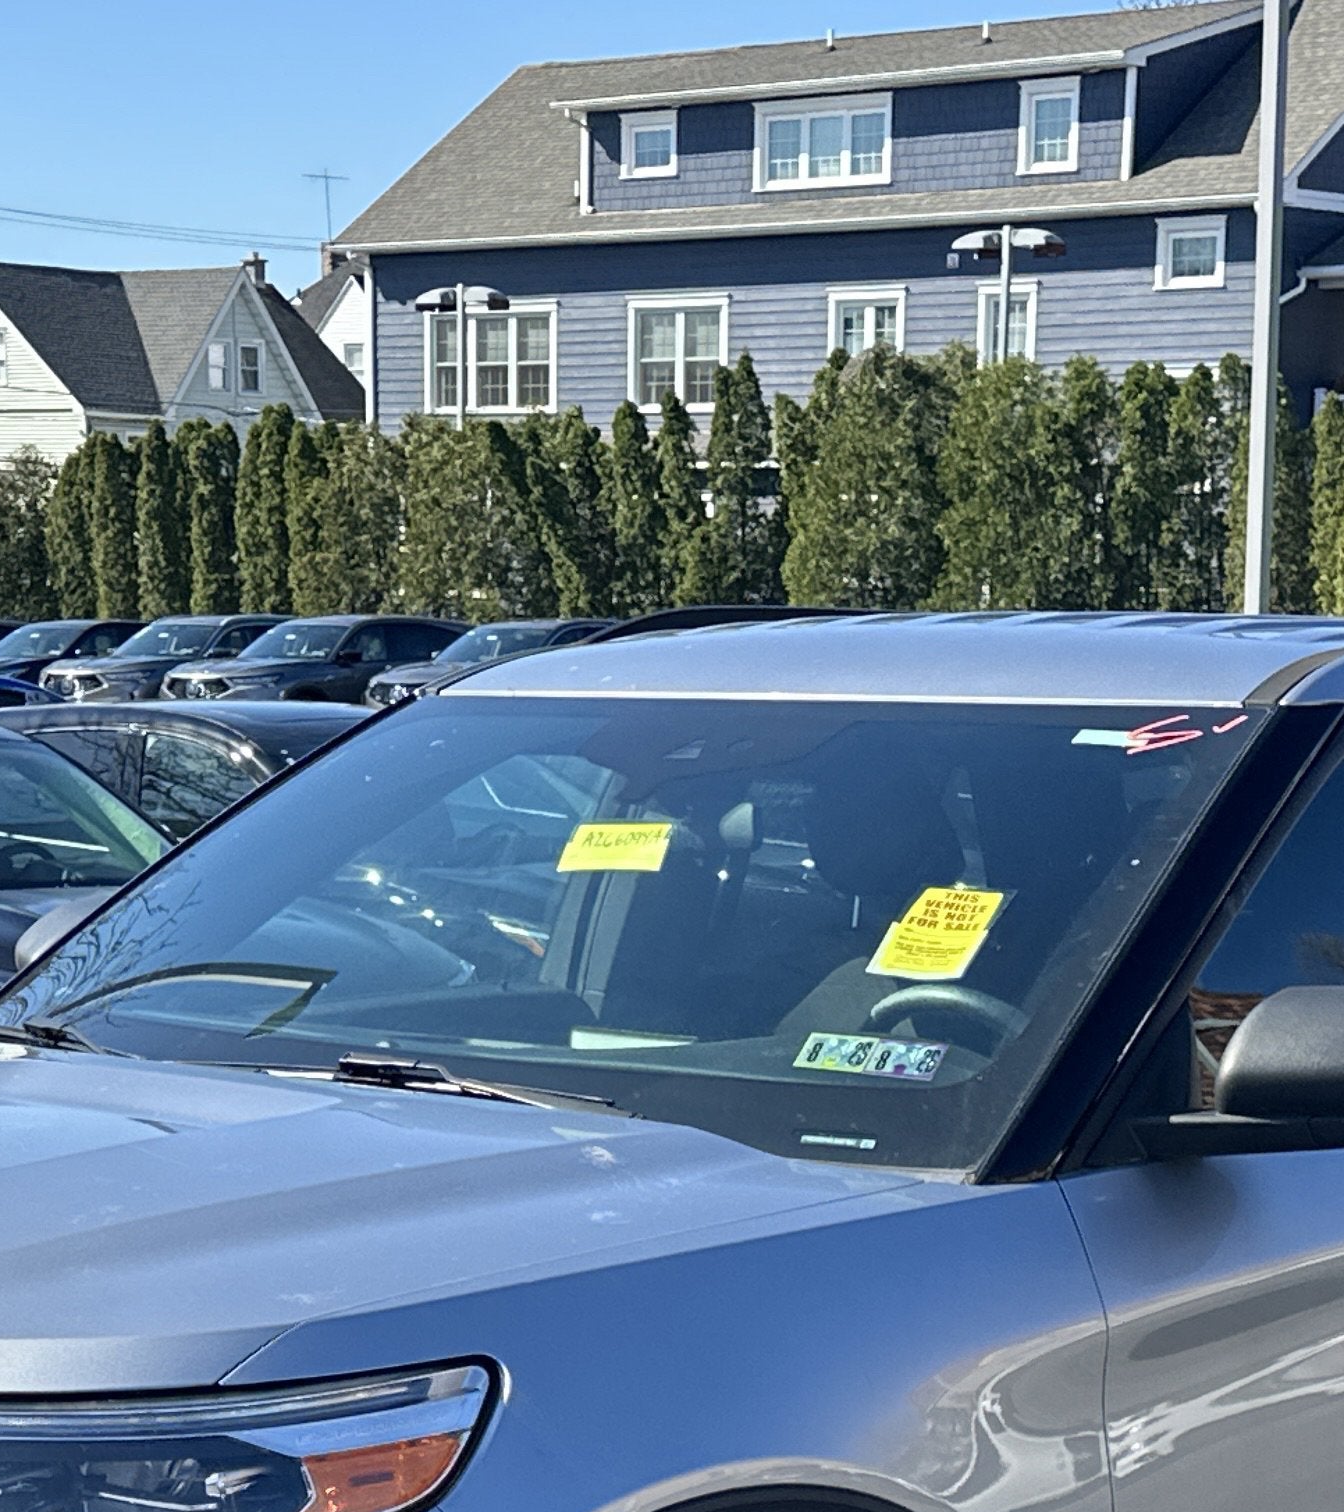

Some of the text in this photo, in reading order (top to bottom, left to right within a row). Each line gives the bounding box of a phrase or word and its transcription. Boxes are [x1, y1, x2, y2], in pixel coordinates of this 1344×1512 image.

[945, 892, 981, 903] THIS
[925, 900, 988, 913] VEHICLE
[923, 908, 977, 922] IS NOT
[906, 916, 981, 931] FOR SALE
[807, 1043, 823, 1062] 8
[875, 1051, 892, 1070] 8
